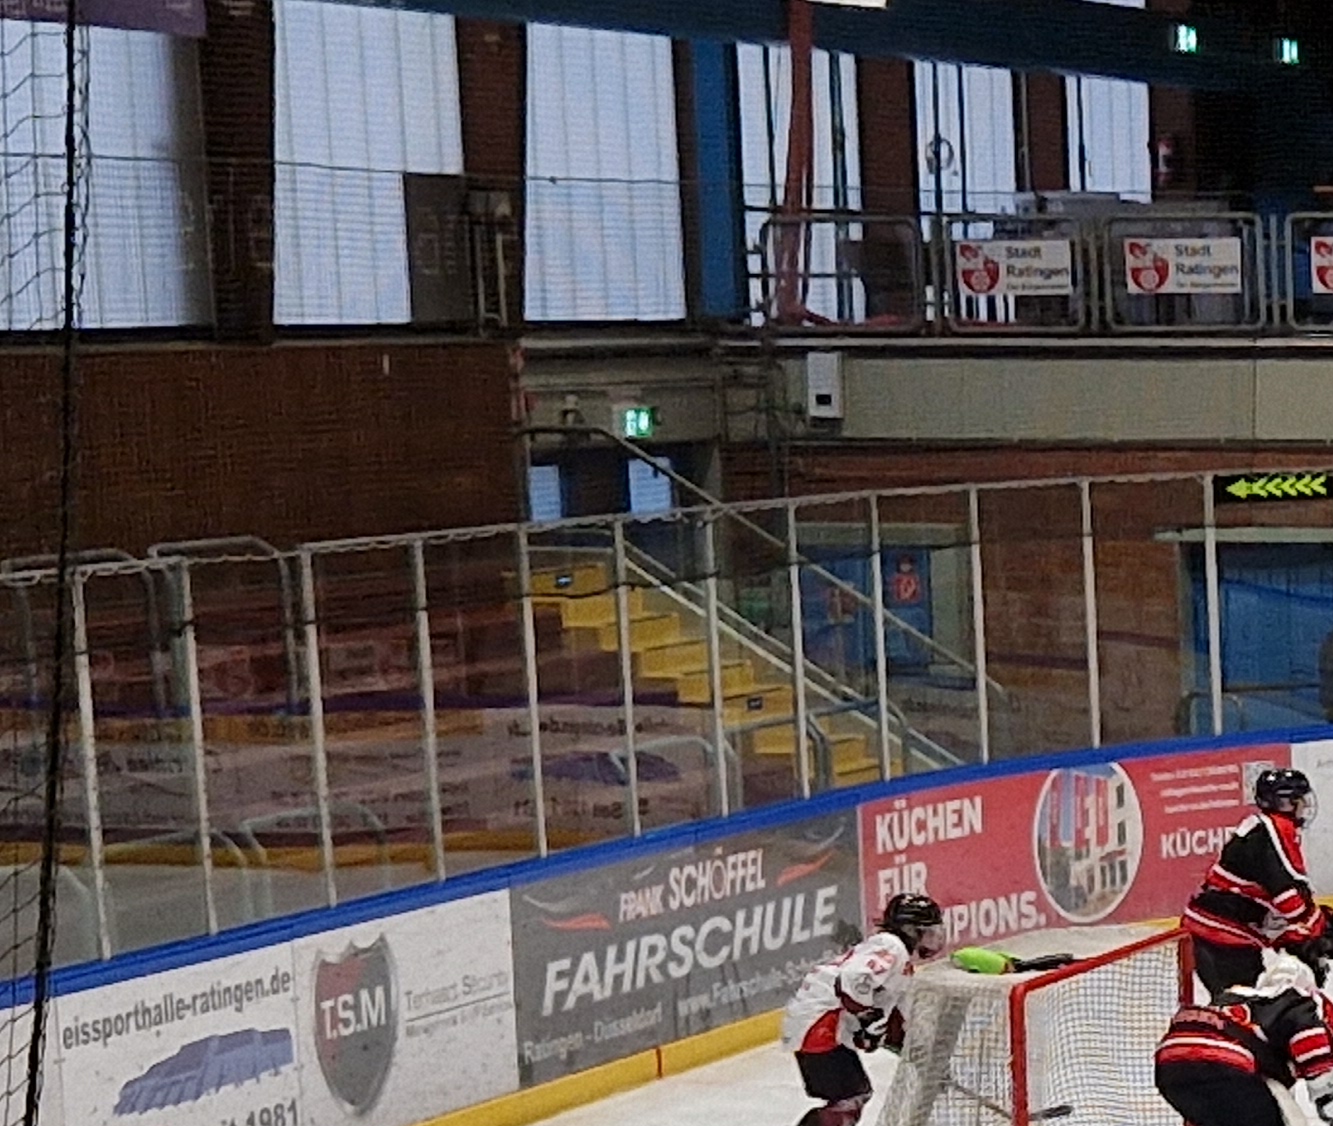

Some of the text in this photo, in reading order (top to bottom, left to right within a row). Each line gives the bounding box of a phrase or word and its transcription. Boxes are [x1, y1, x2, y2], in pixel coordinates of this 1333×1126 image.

[1175, 244, 1211, 256] Stadt
[875, 795, 983, 855] KÜCHEN
[618, 847, 767, 923] FRANK SCHÖFFEL
[878, 854, 928, 911] FÜR
[941, 890, 1047, 945] PIONS.
[541, 884, 839, 1018] FAHRSCHULE
[62, 966, 292, 1050] eissporthalle-ratingen.de
